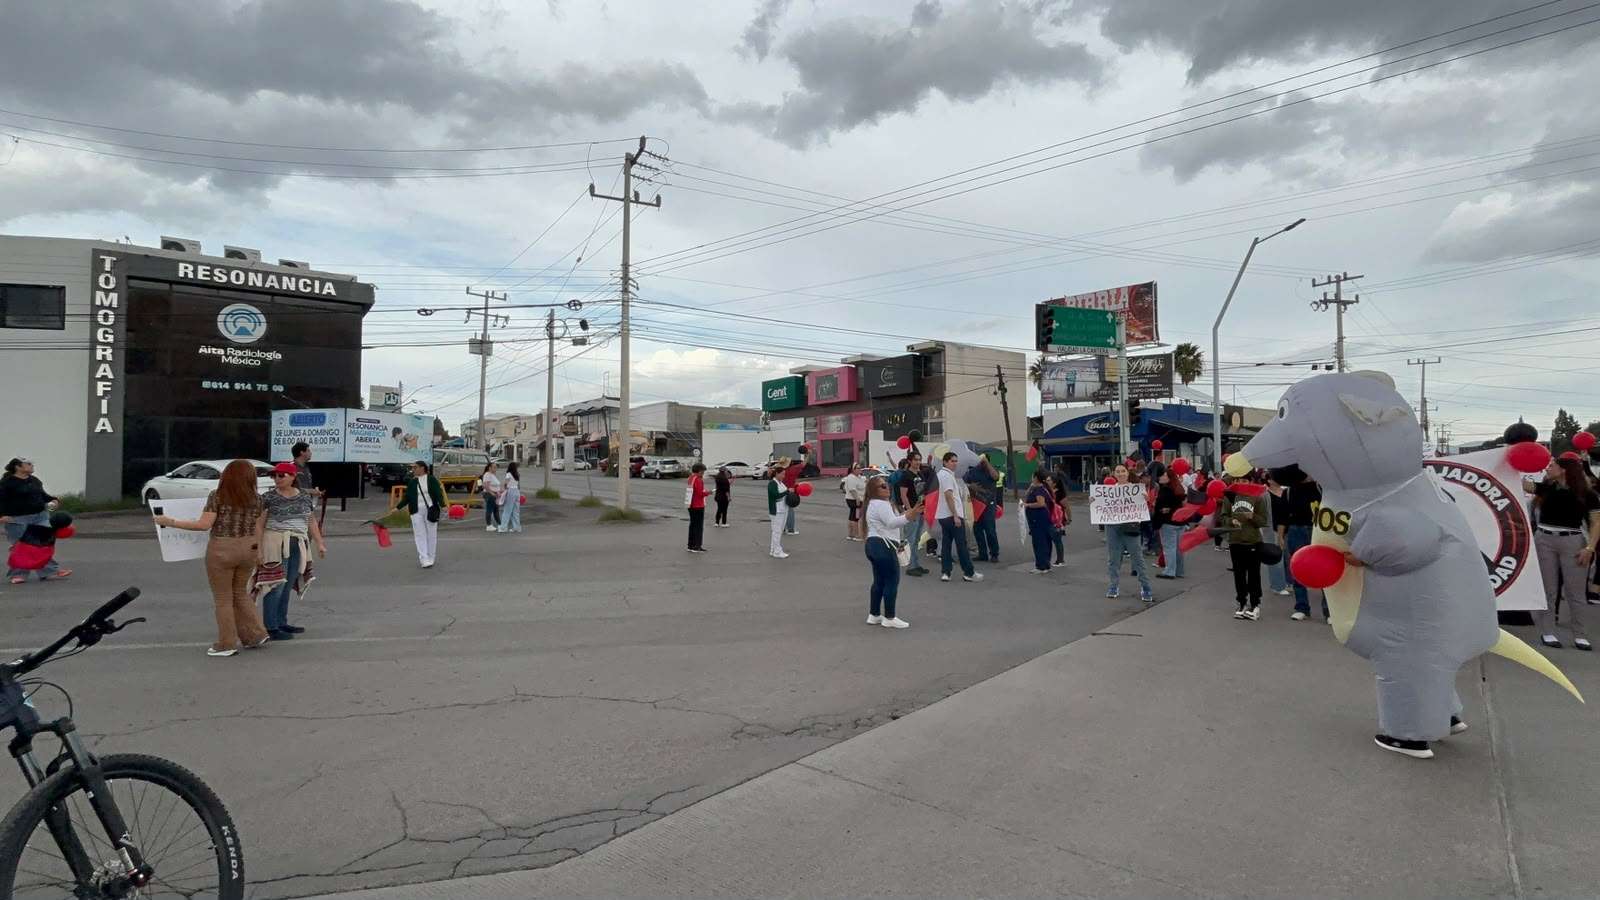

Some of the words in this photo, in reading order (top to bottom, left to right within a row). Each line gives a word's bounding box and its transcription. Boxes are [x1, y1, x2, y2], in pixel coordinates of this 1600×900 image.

[178, 262, 337, 296] RESONANCIA
[227, 347, 282, 360] Radiología
[221, 355, 261, 366] México
[1095, 485, 1140, 498] SEGURO
[1104, 497, 1135, 506] SOCIAL
[1100, 512, 1144, 522] NACIONAL
[222, 825, 239, 880] KENDA
